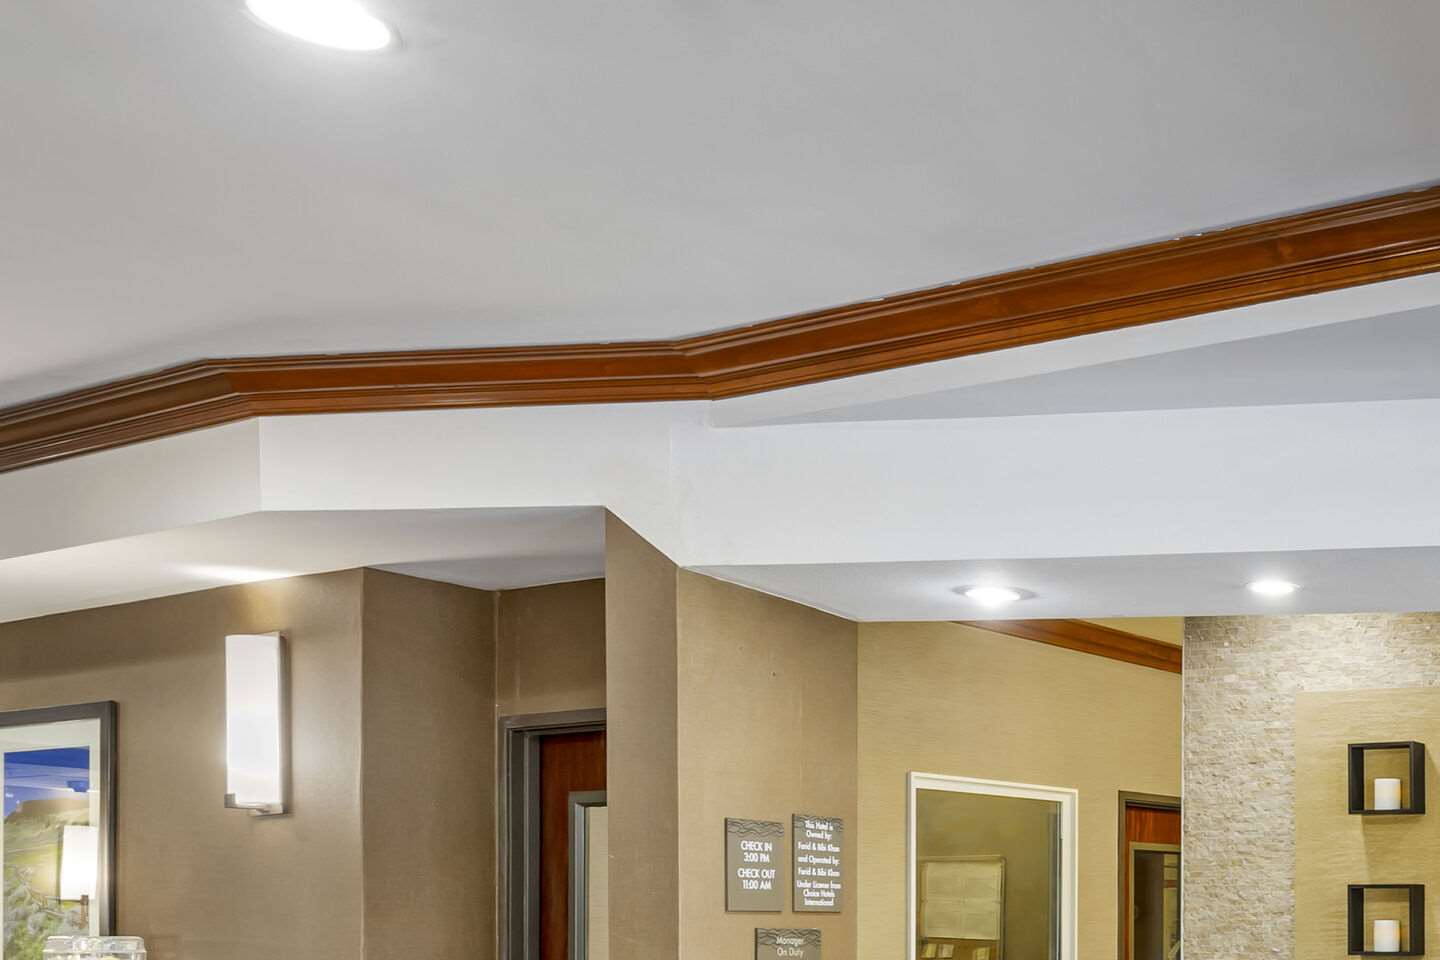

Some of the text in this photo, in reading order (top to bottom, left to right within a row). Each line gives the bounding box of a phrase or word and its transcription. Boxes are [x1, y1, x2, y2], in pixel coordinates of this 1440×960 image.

[740, 840, 773, 852] CHECK IN
[743, 852, 770, 863] 3:00 PM
[737, 867, 776, 879] CHECK OUT
[743, 879, 772, 890] 11:00 AM
[776, 936, 804, 947] Manager
[776, 946, 804, 958] On Duty
